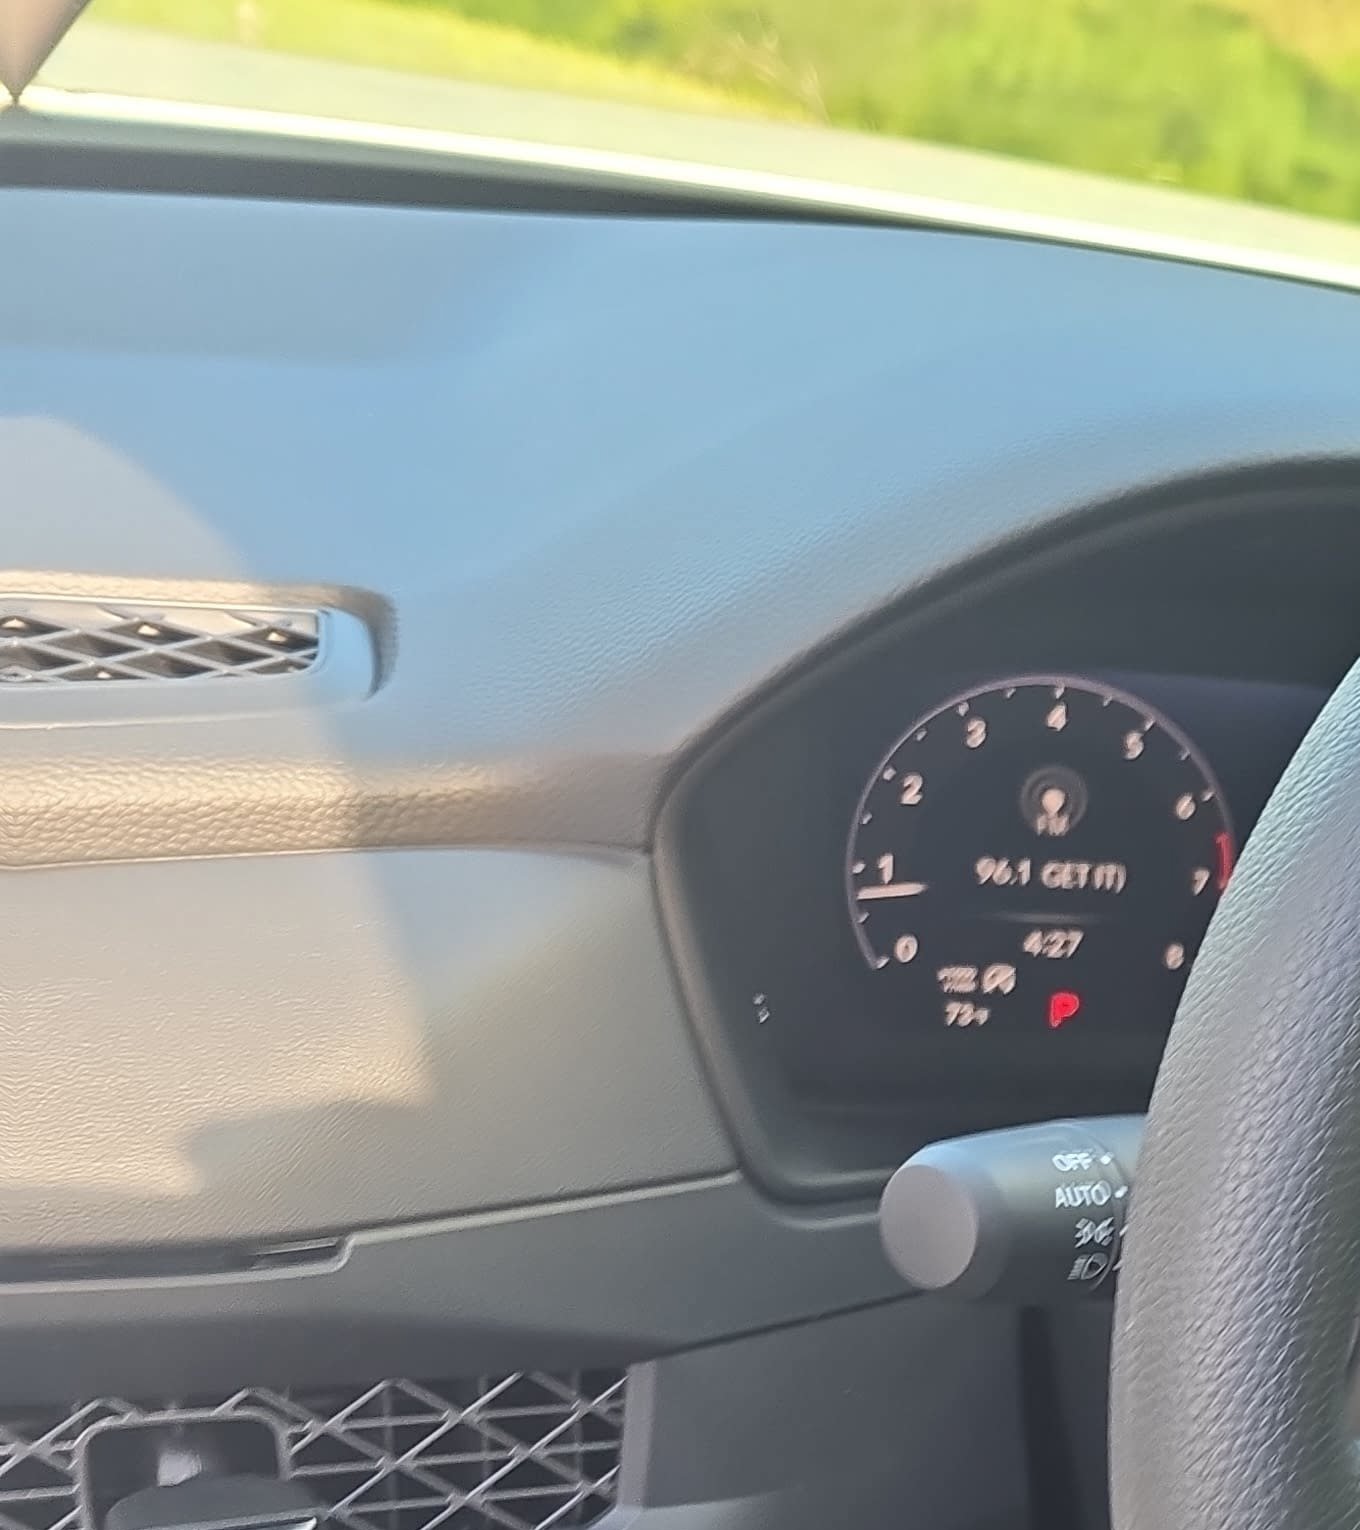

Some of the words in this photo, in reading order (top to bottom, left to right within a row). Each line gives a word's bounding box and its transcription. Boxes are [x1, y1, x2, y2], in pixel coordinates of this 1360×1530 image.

[1046, 703, 1068, 732] 4
[964, 718, 988, 749] 3
[1122, 731, 1145, 760] 5
[900, 773, 924, 805] 2
[877, 853, 895, 884] 1
[894, 934, 918, 963] 0
[1050, 992, 1079, 1028] P
[1051, 1151, 1094, 1172] OFF
[1054, 1181, 1112, 1209] AUTO
